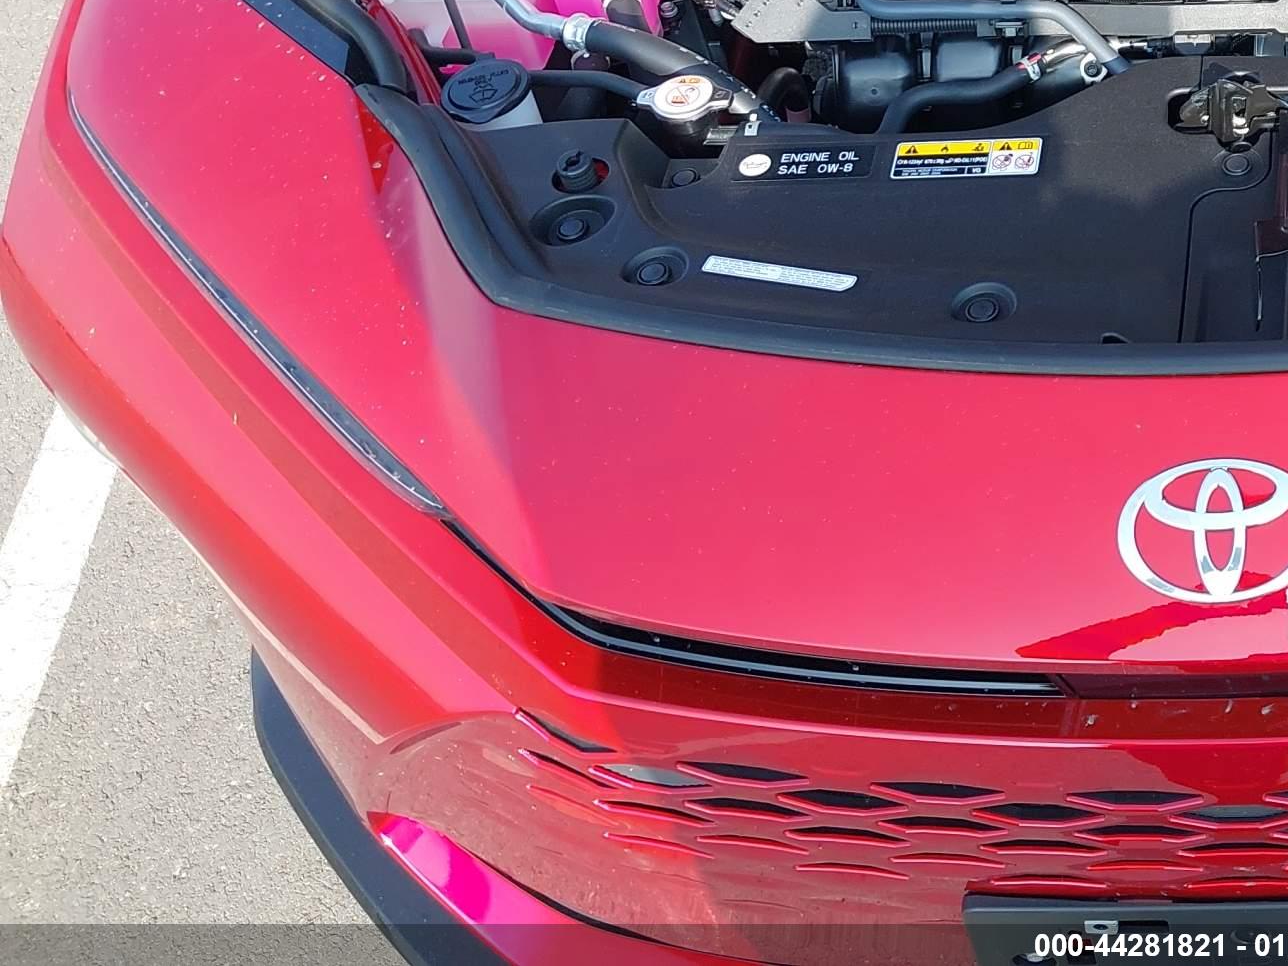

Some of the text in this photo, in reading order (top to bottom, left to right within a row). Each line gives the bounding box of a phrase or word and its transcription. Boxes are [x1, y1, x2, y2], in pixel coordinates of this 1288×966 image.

[780, 150, 860, 164] ENGINE OIL
[777, 164, 809, 175] SAE
